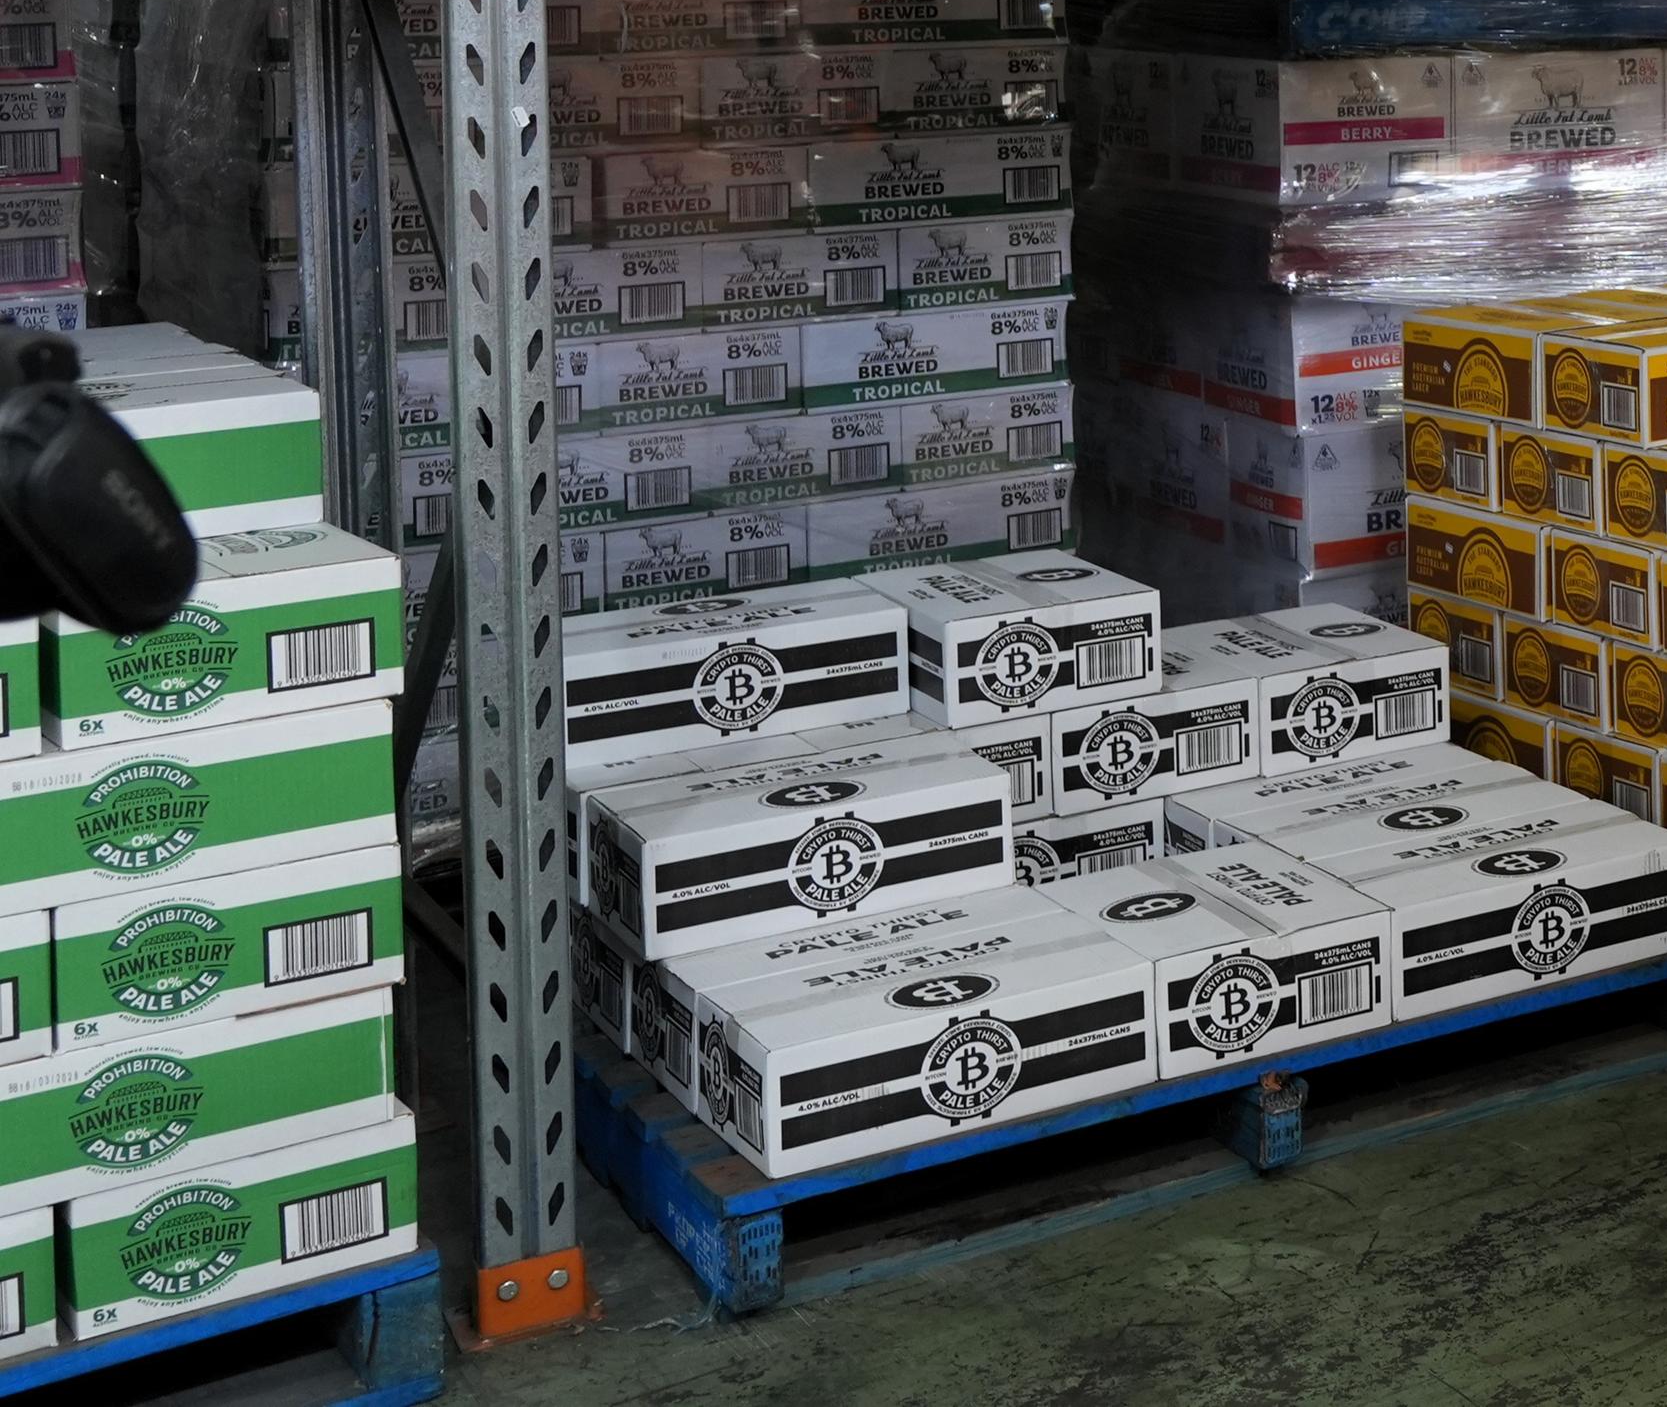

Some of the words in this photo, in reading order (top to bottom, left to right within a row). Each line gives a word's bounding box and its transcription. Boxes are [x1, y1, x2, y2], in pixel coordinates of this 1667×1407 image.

[1618, 57, 1637, 75] 12
[1337, 104, 1396, 118] BREWED
[1340, 126, 1392, 141] BERRY
[1510, 126, 1616, 151] BREWED
[864, 182, 944, 200] BREWED
[859, 204, 952, 222] TROPICAL
[724, 282, 809, 301] BREWED
[718, 304, 816, 323] TROPICAL
[990, 309, 1039, 320] 6x4x375mL
[990, 319, 1021, 335] 8%
[858, 360, 938, 379] BREWED
[852, 380, 945, 402] TROPICAL
[106, 647, 238, 683] HAWKESBURY
[825, 665, 864, 676] 24x375mL
[865, 661, 884, 670] CANS
[123, 685, 178, 712] PALE
[184, 674, 222, 707] ALE
[160, 677, 186, 691] 0%
[89, 766, 192, 804] PROHIBITION
[75, 800, 210, 840] HAWKESBURY
[801, 831, 839, 860] CRYPTO
[839, 829, 871, 852] THIRST
[805, 881, 841, 902] PALE
[842, 869, 871, 898] ALE
[116, 909, 217, 948] PROHIBITION
[101, 942, 235, 984] HAWKESBURY
[1067, 1034, 1109, 1048] 24x375mL
[1110, 1026, 1131, 1036] CANS
[70, 1091, 204, 1136] HAWKESBURY
[133, 1189, 234, 1231] PROHIBITION
[136, 1268, 192, 1294] PALE
[197, 1249, 237, 1287] ALE
